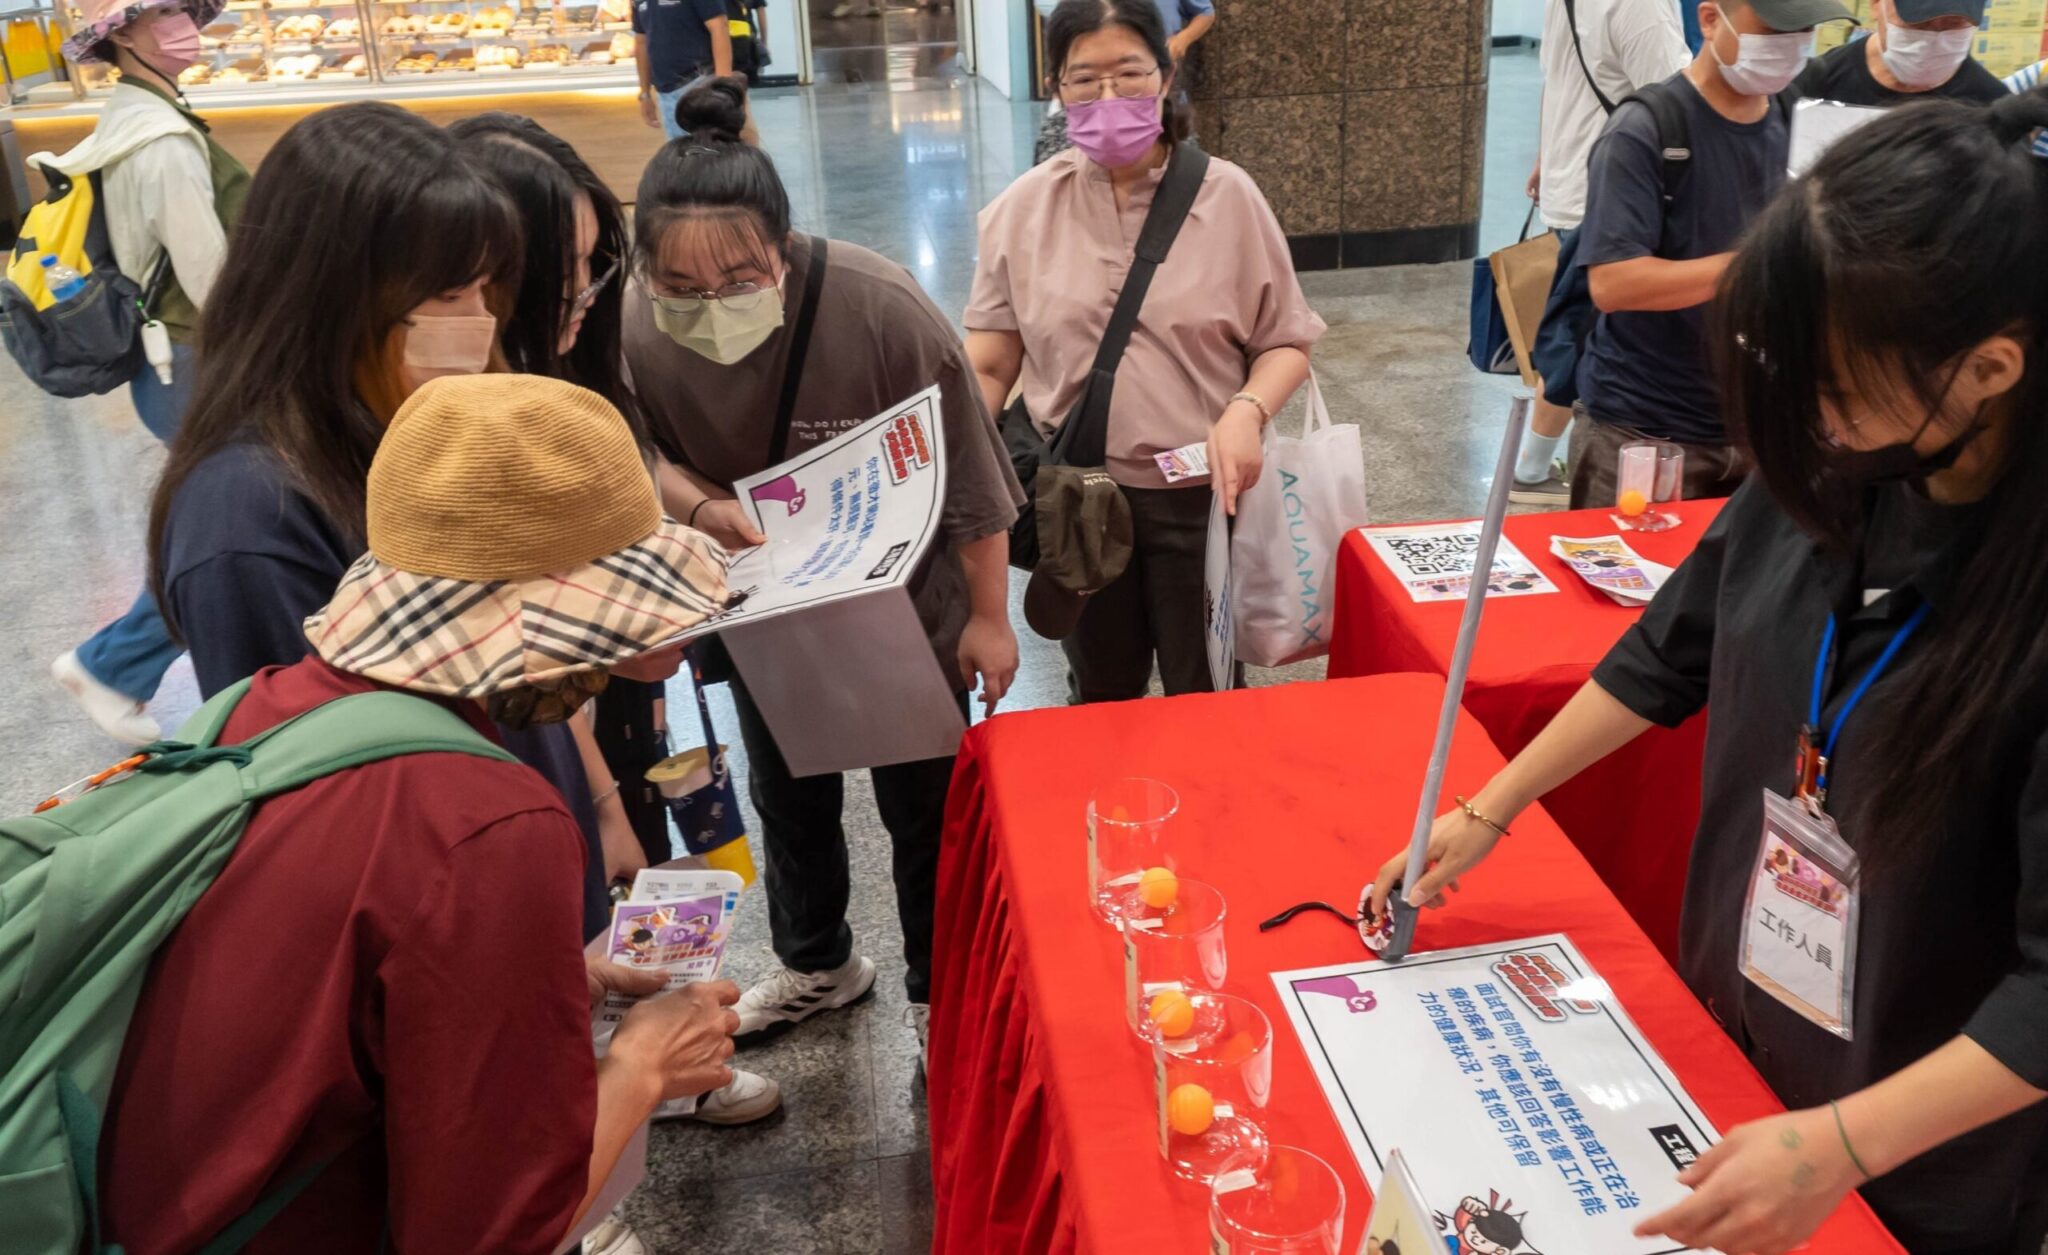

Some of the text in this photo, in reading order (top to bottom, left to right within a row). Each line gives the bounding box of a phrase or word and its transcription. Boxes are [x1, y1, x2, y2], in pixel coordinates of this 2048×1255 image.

[814, 420, 830, 428] DO
[1277, 469, 1322, 646] AQUAMAX
[1759, 906, 1833, 971] 工作人員
[1417, 991, 1542, 1167] 力的健康狀況，其他可保留
[1446, 986, 1608, 1216] 療的疾病，你應該回答影響工作能
[1474, 982, 1640, 1210] 面試官問你有沒有慢性病或正在治
[1660, 1132, 1697, 1168] 工程
